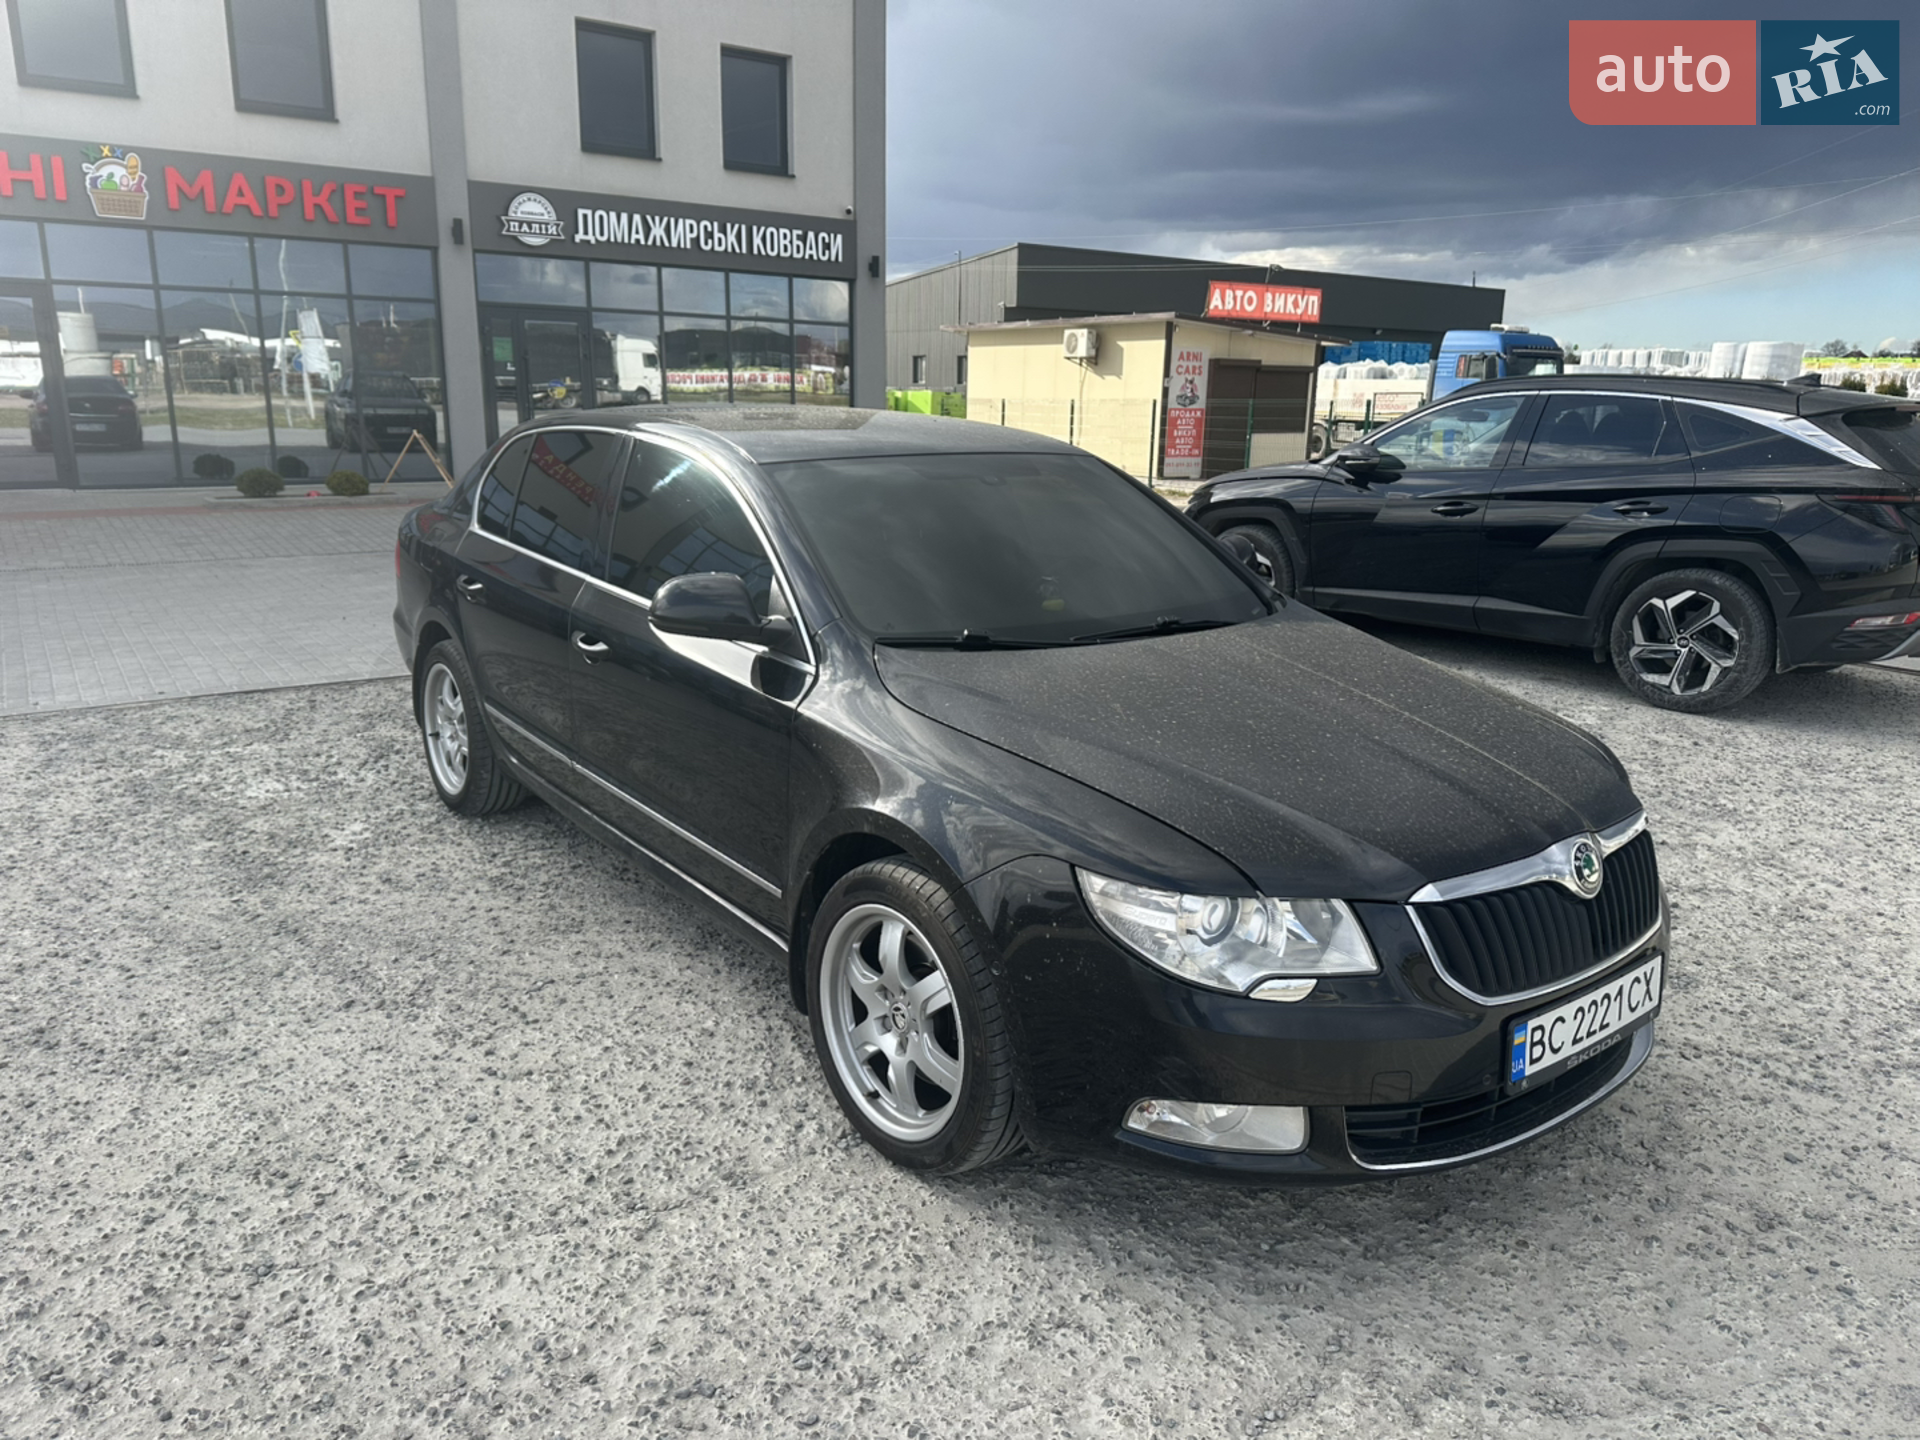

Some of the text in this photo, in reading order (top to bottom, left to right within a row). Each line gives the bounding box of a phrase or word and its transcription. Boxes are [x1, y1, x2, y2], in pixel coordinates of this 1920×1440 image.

[164, 166, 406, 228] МАРКЕТ
[508, 220, 558, 236] ПАЛІЙ
[574, 207, 844, 263] ДОМАЖИРСЬКІ КОВБАСИ
[1209, 288, 1319, 316] АВТО ВИКУП
[1177, 350, 1203, 363] ARNI
[1175, 364, 1204, 376] CARS
[1170, 410, 1202, 418] ПРОДАЖ
[1173, 429, 1197, 437] ВИКУП
[1167, 448, 1200, 456] TRADE-IN
[1528, 1015, 1566, 1067] BC
[1511, 1062, 1525, 1073] UA
